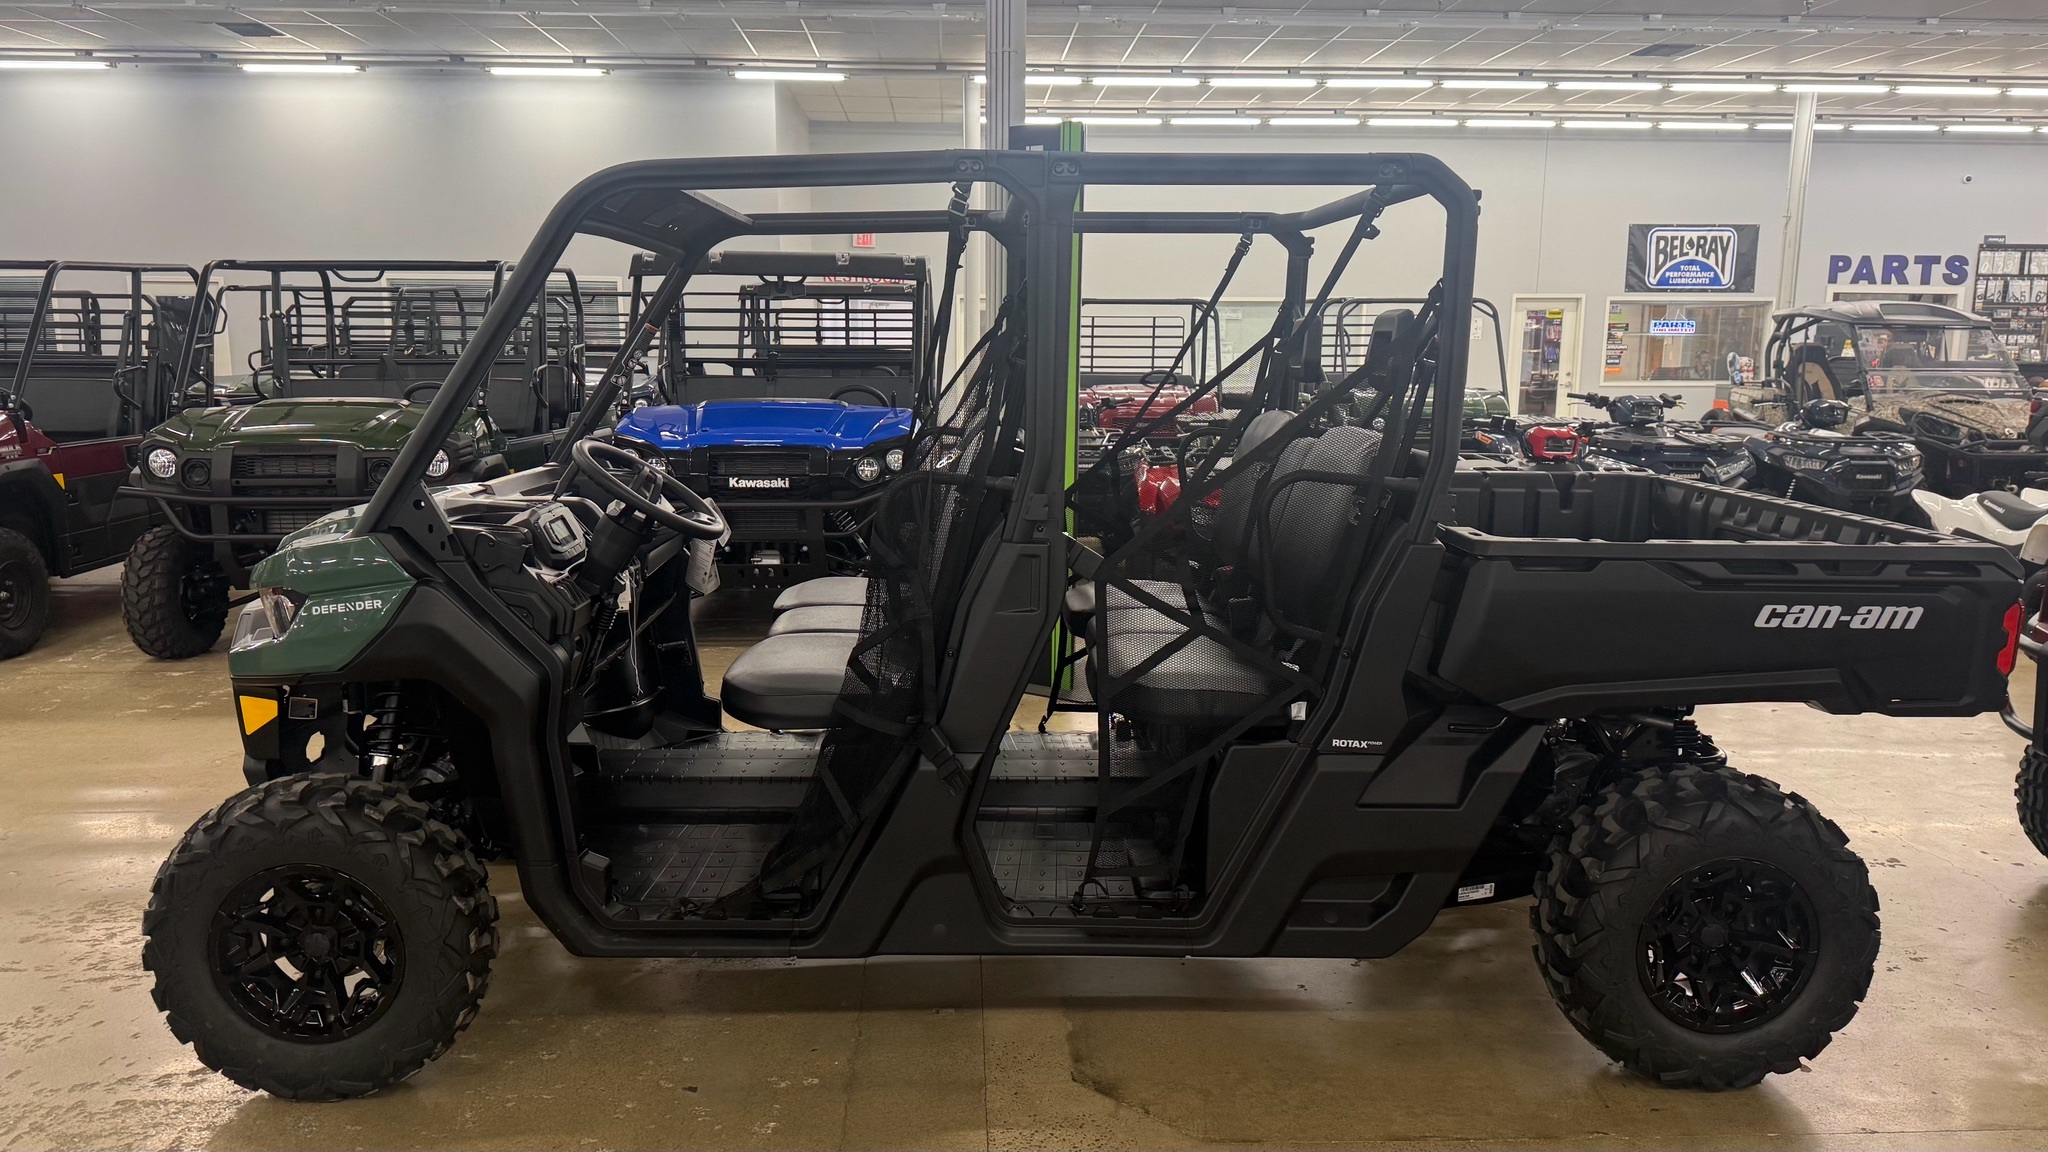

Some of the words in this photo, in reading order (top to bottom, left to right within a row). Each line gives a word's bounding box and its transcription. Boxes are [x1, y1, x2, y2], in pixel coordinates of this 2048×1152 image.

[1827, 254, 1970, 286] PARTS
[728, 477, 790, 488] Kawasaki
[312, 600, 382, 615] DEFENDER
[1332, 739, 1368, 748] ROTAX
